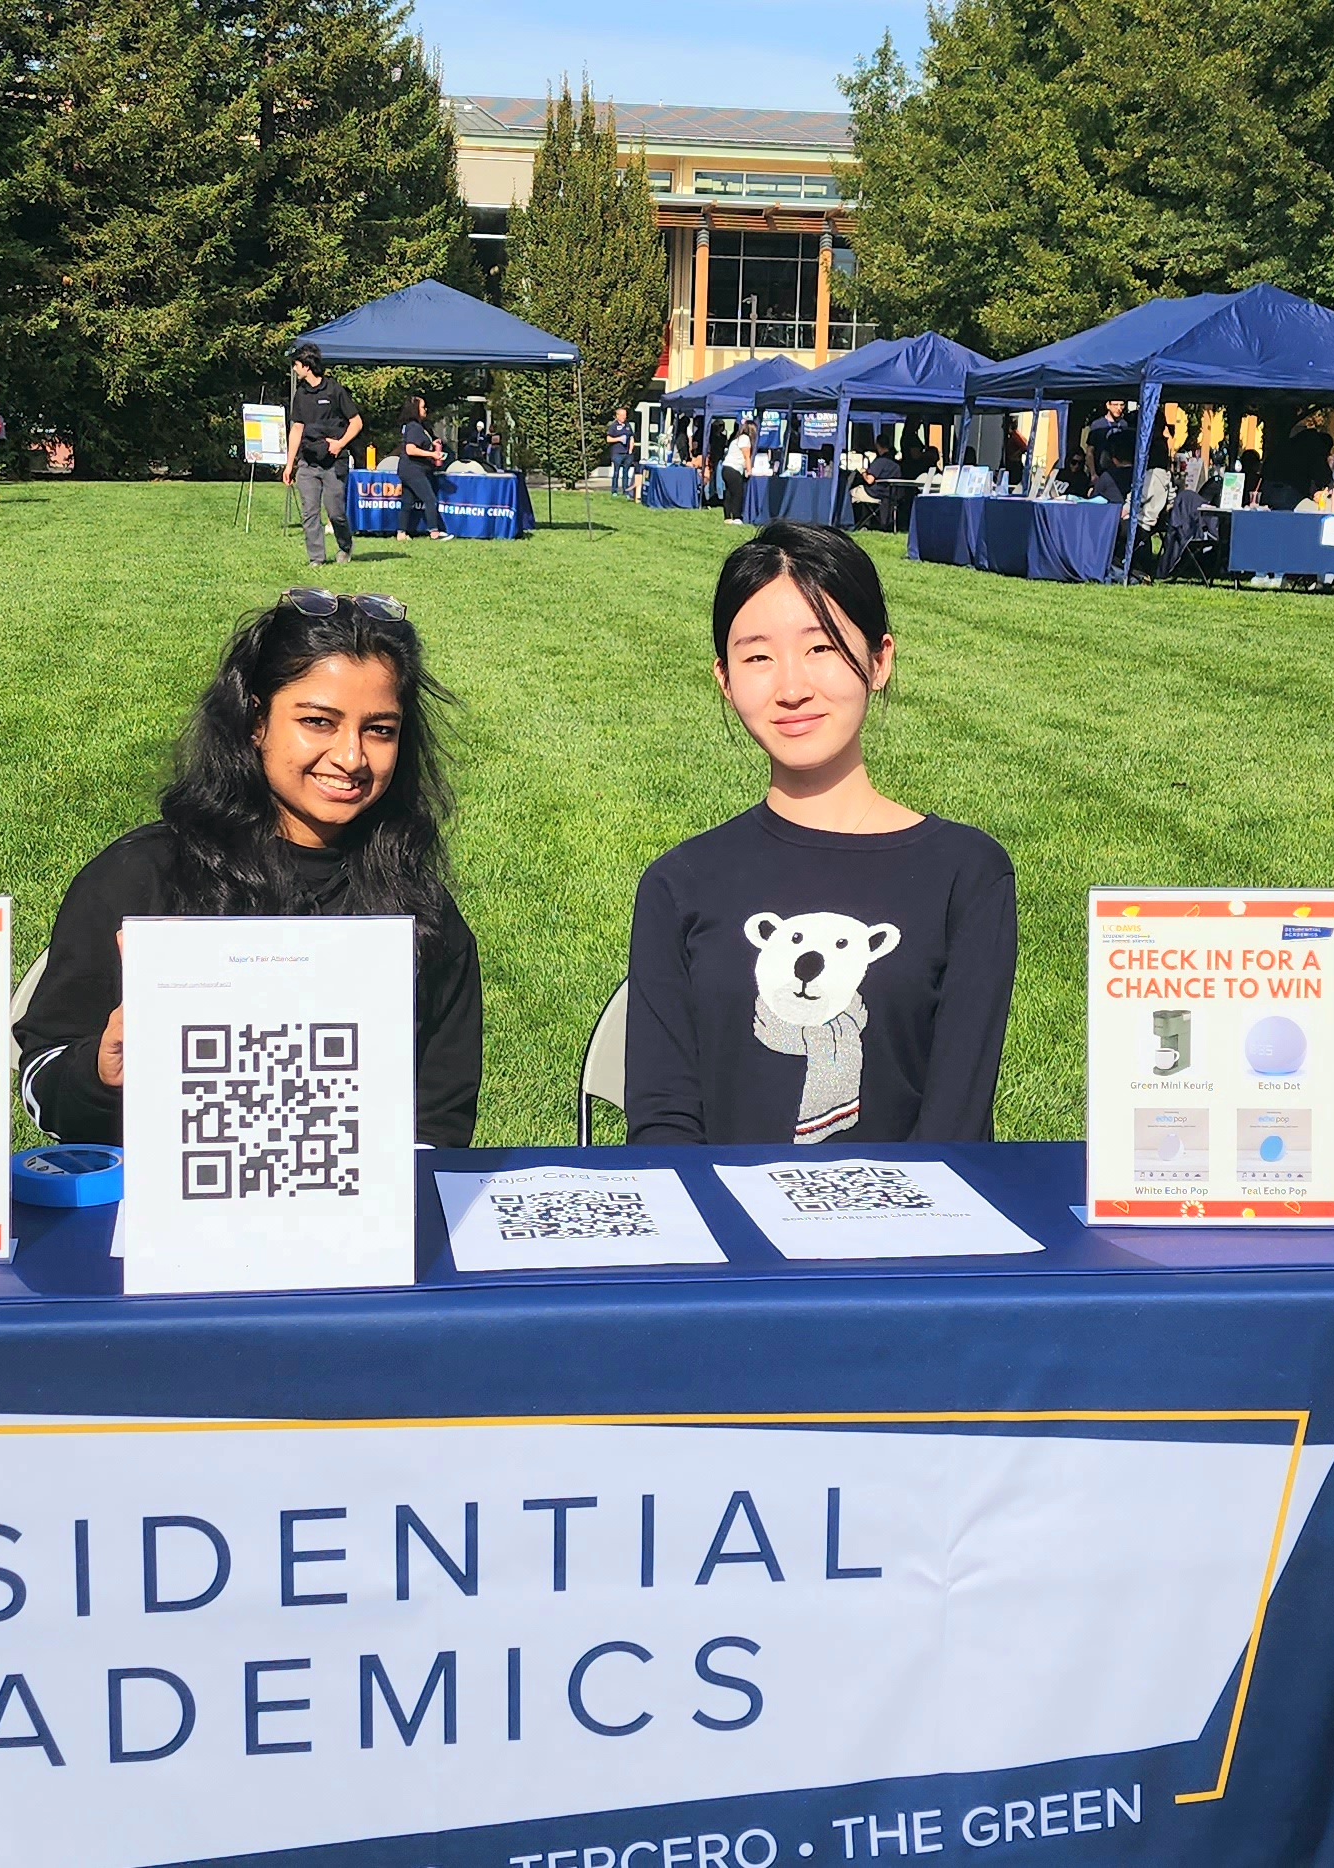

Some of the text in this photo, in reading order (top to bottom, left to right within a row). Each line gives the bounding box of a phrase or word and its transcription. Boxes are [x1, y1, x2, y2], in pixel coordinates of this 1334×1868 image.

[357, 482, 403, 497] UCDA
[439, 504, 485, 516] RESEARCH
[229, 956, 255, 964] Major's
[1109, 949, 1321, 970] CHECK IN FOR A
[1106, 978, 1322, 998] CHANCE TO WIN
[1130, 1080, 1214, 1092] Green Mini Keurig
[1258, 1081, 1301, 1091] Echo Dot
[479, 1172, 640, 1185] Major Card Sort
[1135, 1186, 1209, 1196] White Echo Pop
[1241, 1186, 1308, 1196] Teal Echo Pop
[832, 1808, 944, 1860] THE
[961, 1783, 1142, 1848] GREEN
